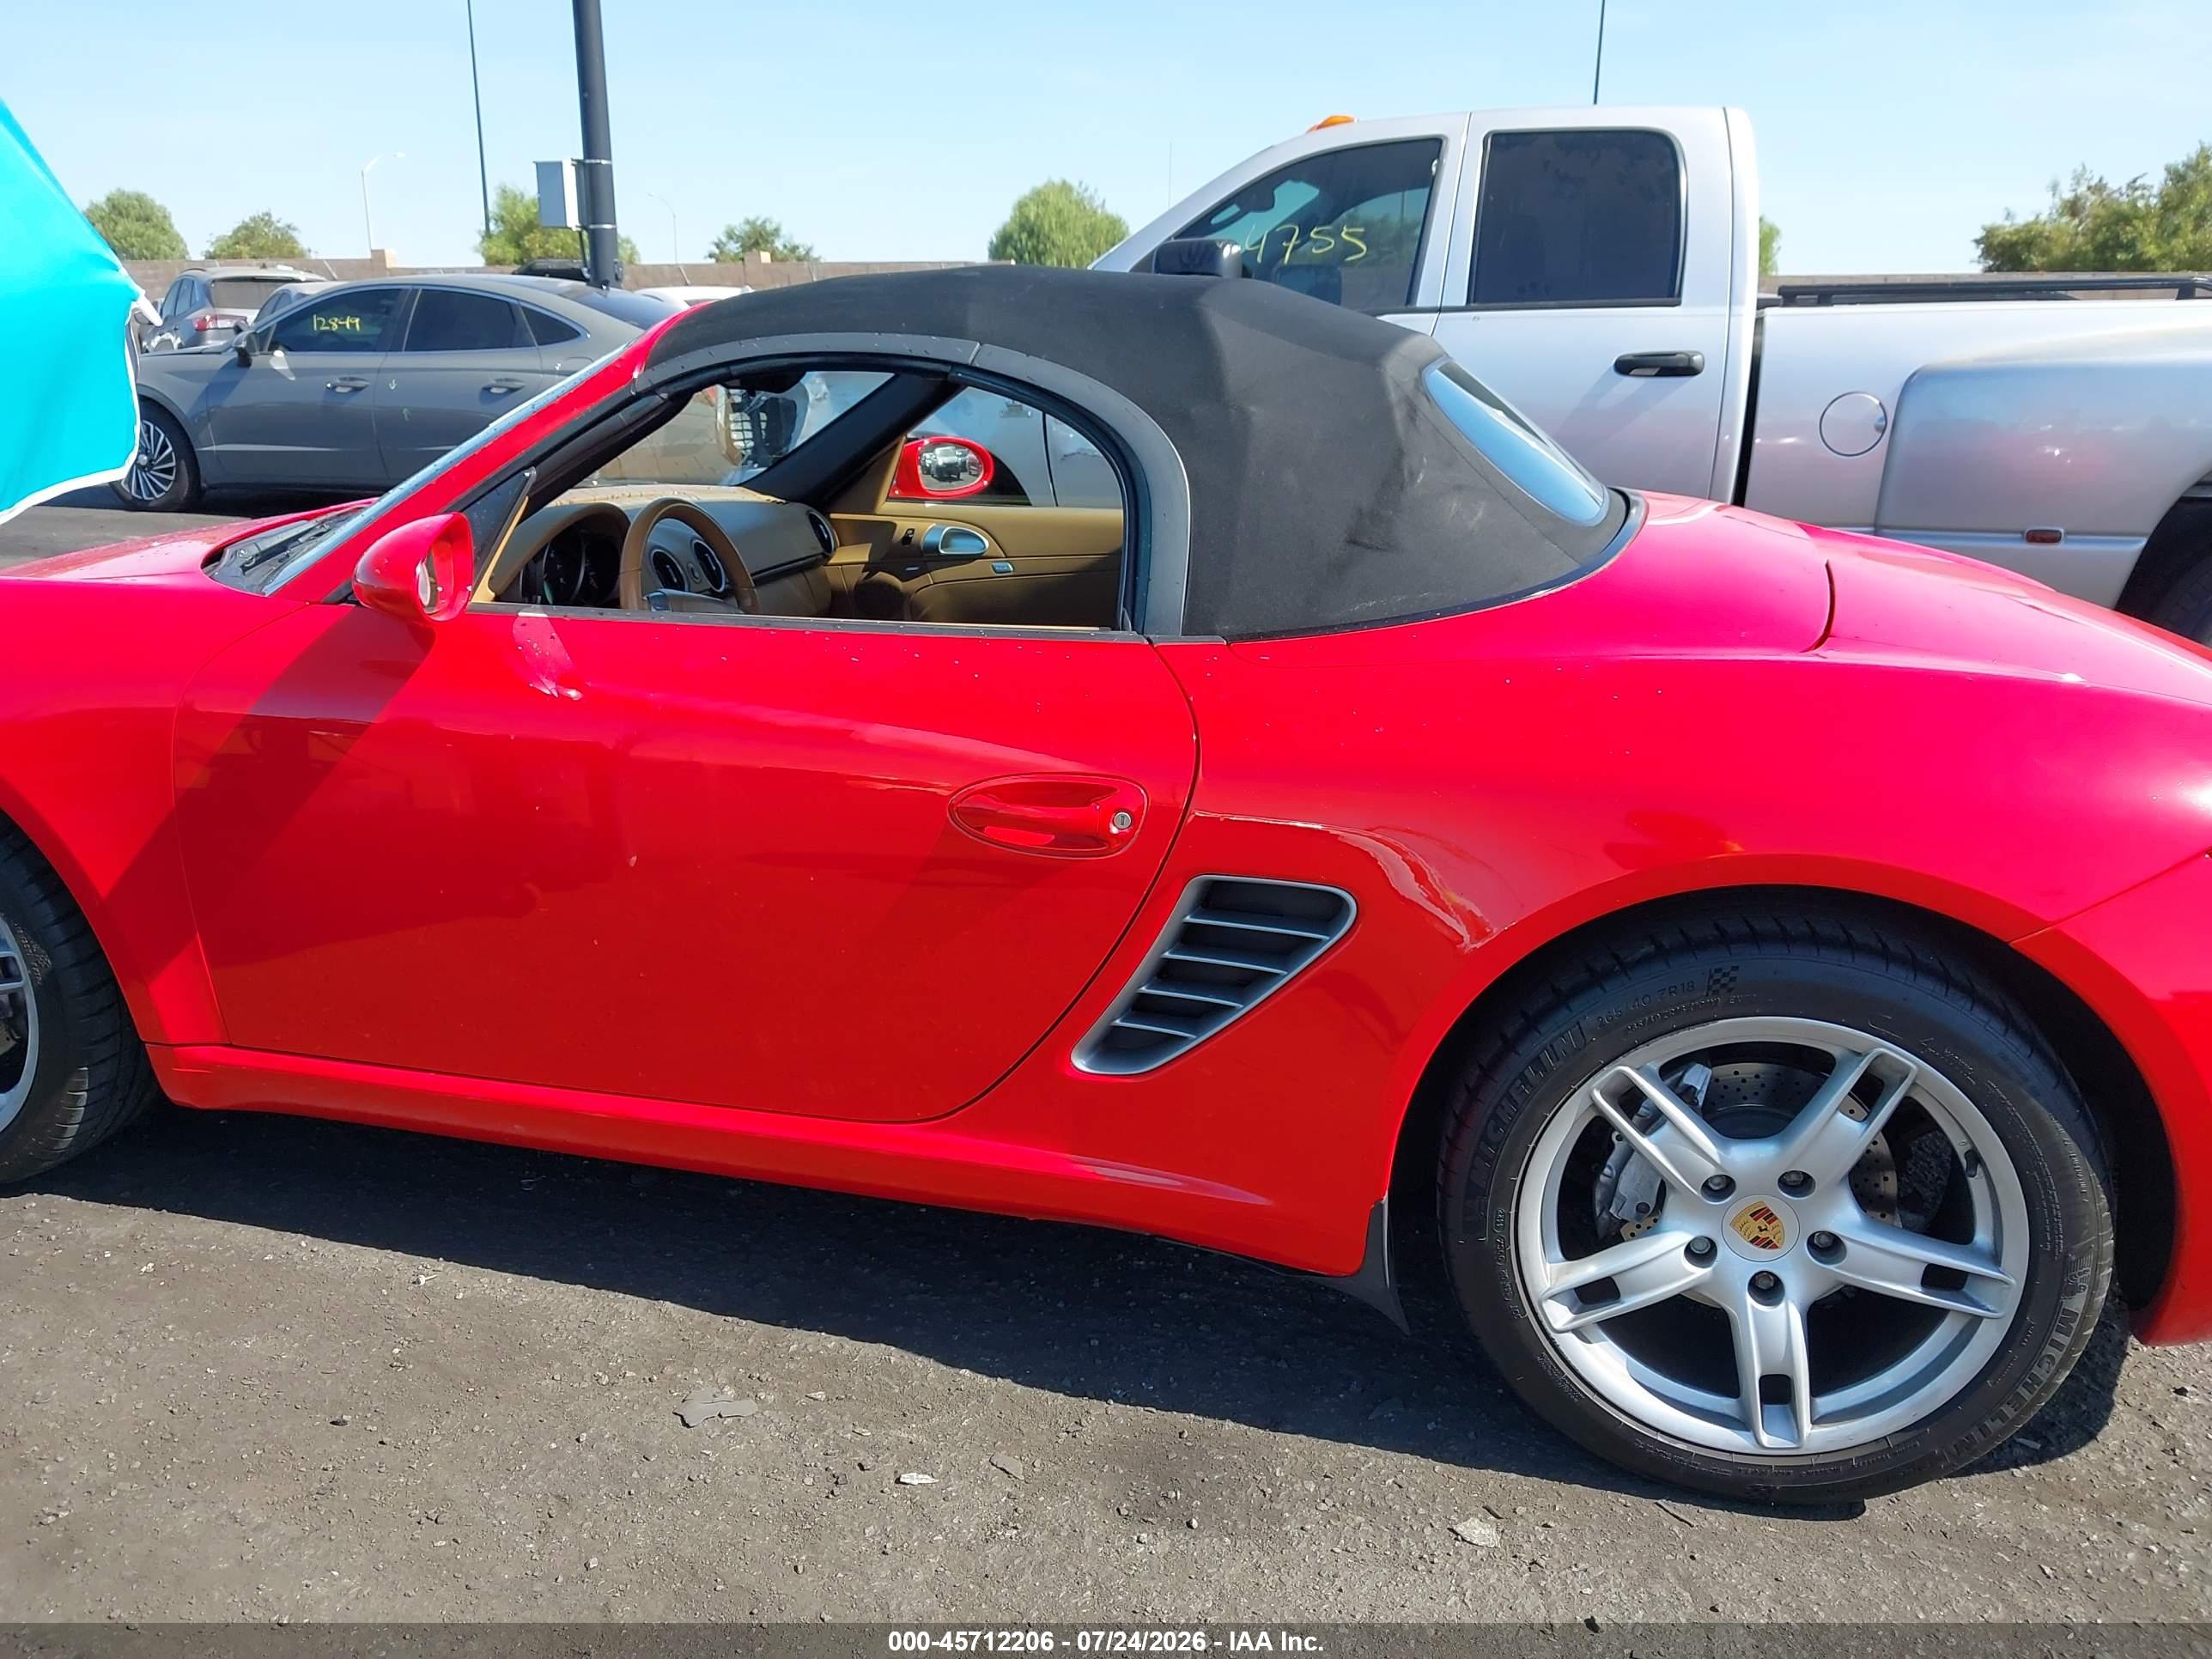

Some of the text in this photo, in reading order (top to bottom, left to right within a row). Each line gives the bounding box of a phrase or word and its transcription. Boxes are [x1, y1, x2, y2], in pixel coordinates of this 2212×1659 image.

[1244, 222, 1368, 264] 4755
[313, 313, 361, 332] 12849
[1468, 1020, 1587, 1190] MICHELIN
[1949, 1306, 2081, 1459] MICHELIN
